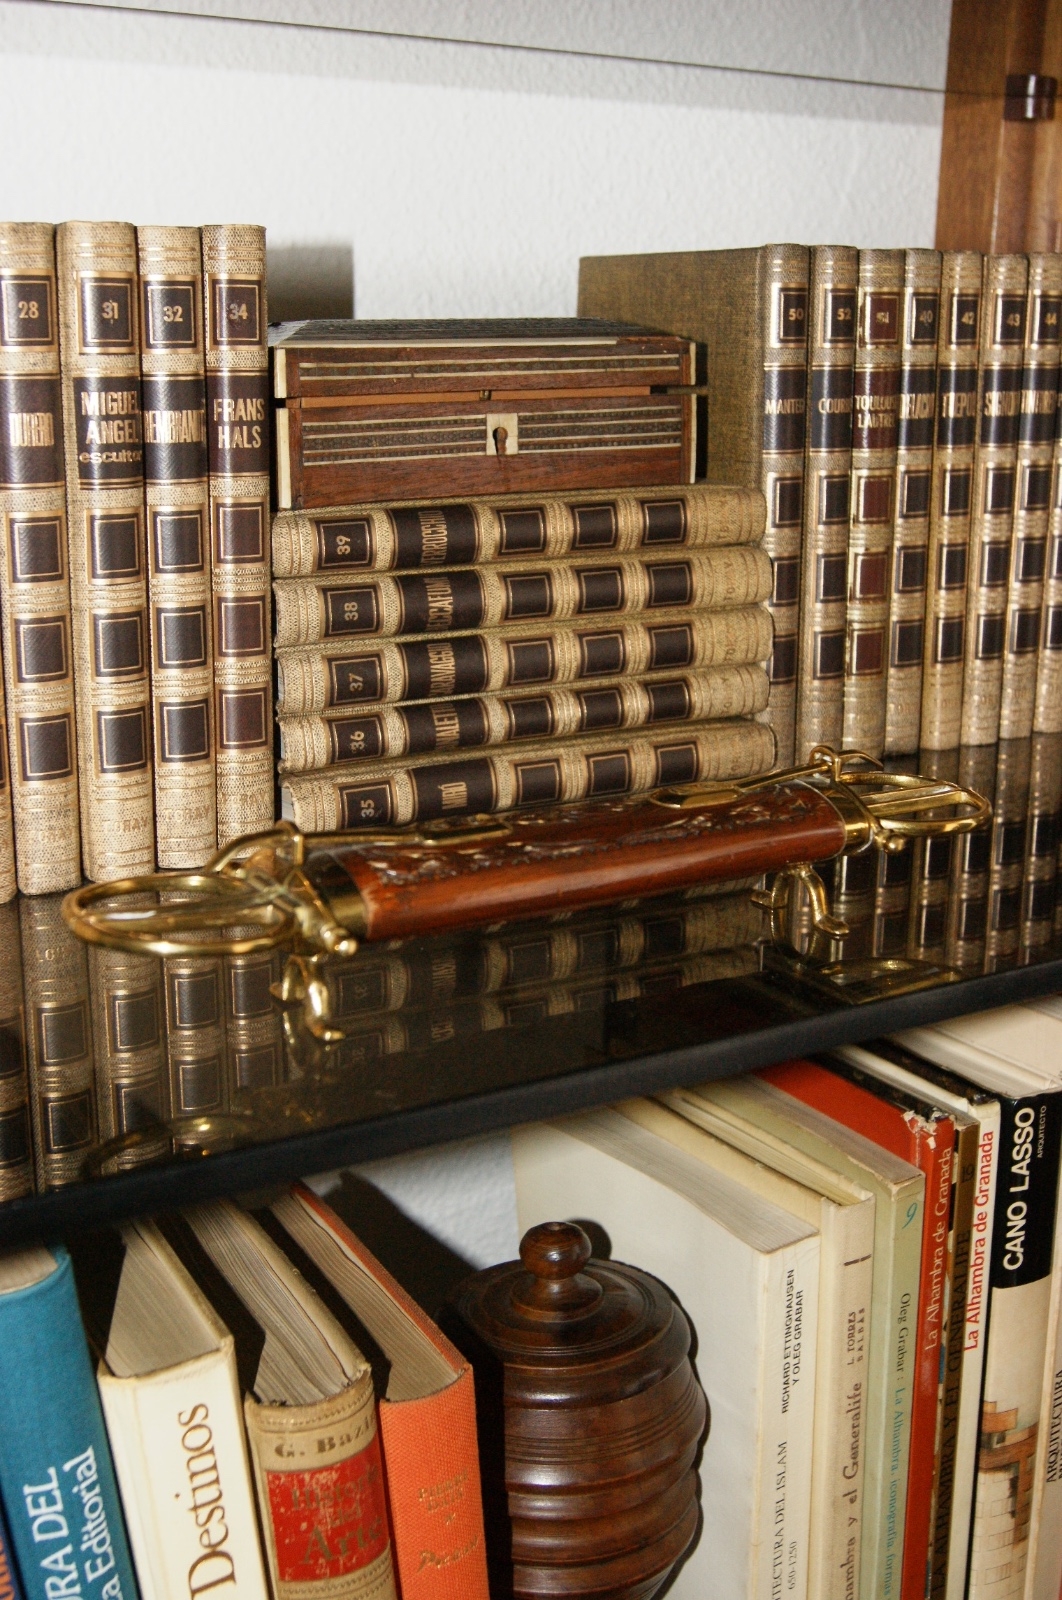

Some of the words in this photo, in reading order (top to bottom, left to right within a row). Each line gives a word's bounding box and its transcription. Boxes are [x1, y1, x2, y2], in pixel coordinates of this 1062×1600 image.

[18, 301, 40, 319] 28
[102, 301, 119, 319] 31
[163, 304, 184, 322] 32
[229, 302, 249, 321] 34
[788, 308, 804, 321] 50
[837, 308, 852, 321] 52
[1006, 313, 1021, 327] 43
[81, 391, 139, 416] MIGUEL
[213, 398, 265, 422] FRANS
[8, 412, 54, 447] DURERO
[86, 420, 139, 445] ANGEL
[218, 425, 262, 449] HALS
[337, 535, 351, 556] 39
[344, 601, 359, 621] 38
[350, 673, 364, 692] 37
[351, 730, 365, 750] 36
[360, 798, 375, 818] 35
[437, 781, 468, 810] MIRÓ
[1037, 1105, 1047, 1159] ARQUITECTO
[1009, 1106, 1035, 1193] LASSO
[935, 1146, 952, 1217] Granada
[975, 1131, 994, 1207] Granada
[932, 1222, 946, 1243] de
[973, 1211, 987, 1234] de
[1003, 1200, 1028, 1271] CANO
[926, 1247, 943, 1323] Alhambra
[966, 1236, 986, 1324] Alhambra
[784, 1269, 795, 1360] ETTINGHAUSEN
[794, 1289, 804, 1340] GRABAR
[897, 1293, 911, 1326] Oleg
[896, 1328, 909, 1372] Grabar
[925, 1329, 938, 1350] La
[963, 1329, 979, 1352] La
[792, 1342, 801, 1375] OLEG
[781, 1360, 792, 1414] RICHARD
[792, 1378, 800, 1386] Y
[895, 1387, 905, 1405] La
[843, 1382, 862, 1480] Generalife
[274, 1443, 306, 1458] G.
[776, 1441, 788, 1491] ISLAM
[23, 1466, 69, 1543] DEL
[174, 1403, 237, 1600] Destinos
[774, 1493, 786, 1525] DEL
[842, 1488, 858, 1505] el
[62, 1445, 116, 1583] Editorial
[848, 1516, 858, 1528] y
[299, 1516, 384, 1565] Arte
[787, 1540, 798, 1590] 650-1250
[883, 1553, 896, 1597] formas
